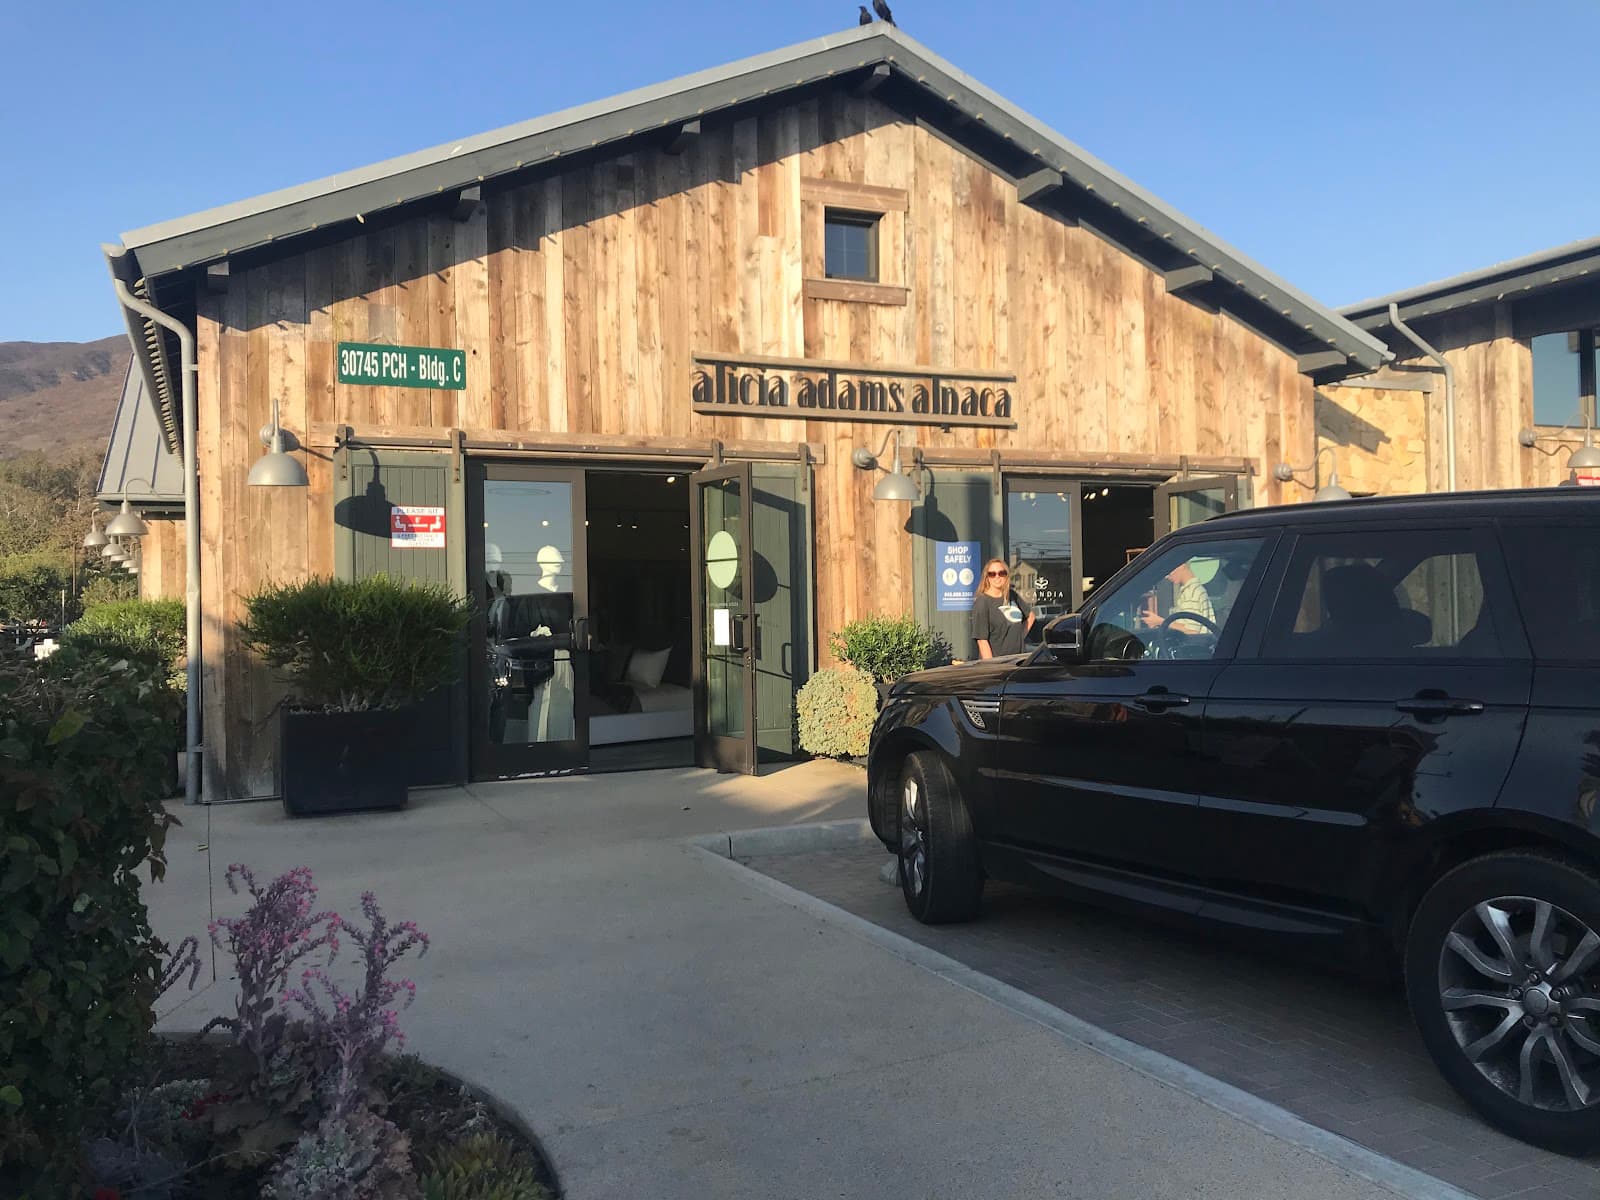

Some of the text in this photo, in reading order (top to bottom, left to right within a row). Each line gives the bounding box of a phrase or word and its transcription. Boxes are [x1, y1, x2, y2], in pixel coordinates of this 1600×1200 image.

[341, 349, 379, 377] 30745
[382, 351, 407, 379] PCH
[419, 354, 449, 386] Bldg.
[453, 356, 461, 382] C
[692, 360, 787, 407] alicia
[797, 368, 905, 413] adams
[944, 555, 972, 563] SAFELY
[947, 546, 969, 554] SHOP
